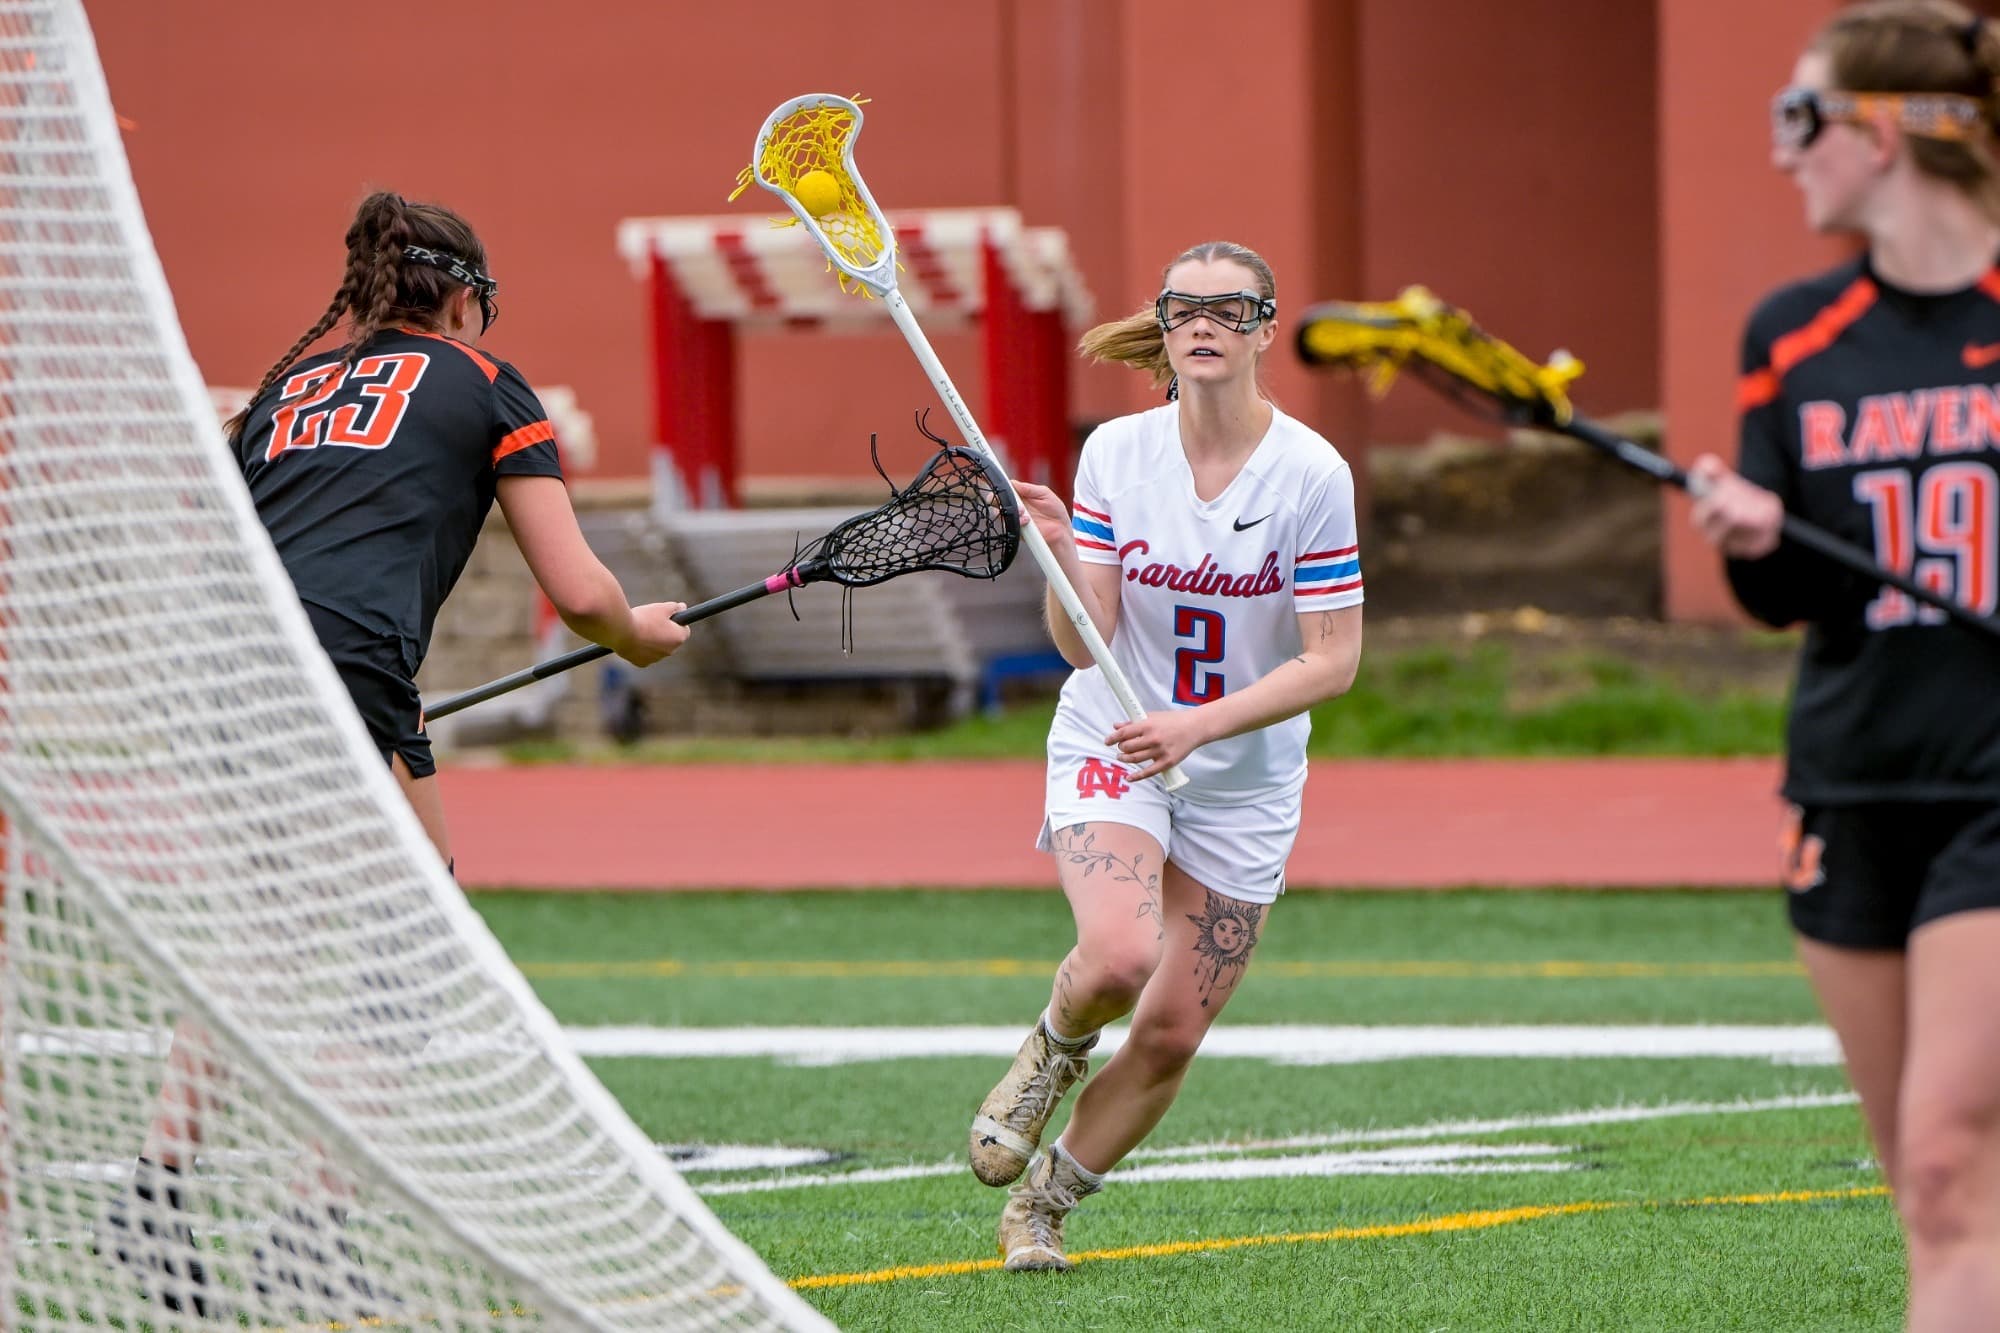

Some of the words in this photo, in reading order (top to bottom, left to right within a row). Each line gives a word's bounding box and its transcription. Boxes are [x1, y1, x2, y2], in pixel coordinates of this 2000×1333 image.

[264, 352, 430, 463] 23
[1118, 539, 1285, 599] Cardinals
[1852, 460, 2000, 631] 19
[1172, 604, 1227, 706] 2
